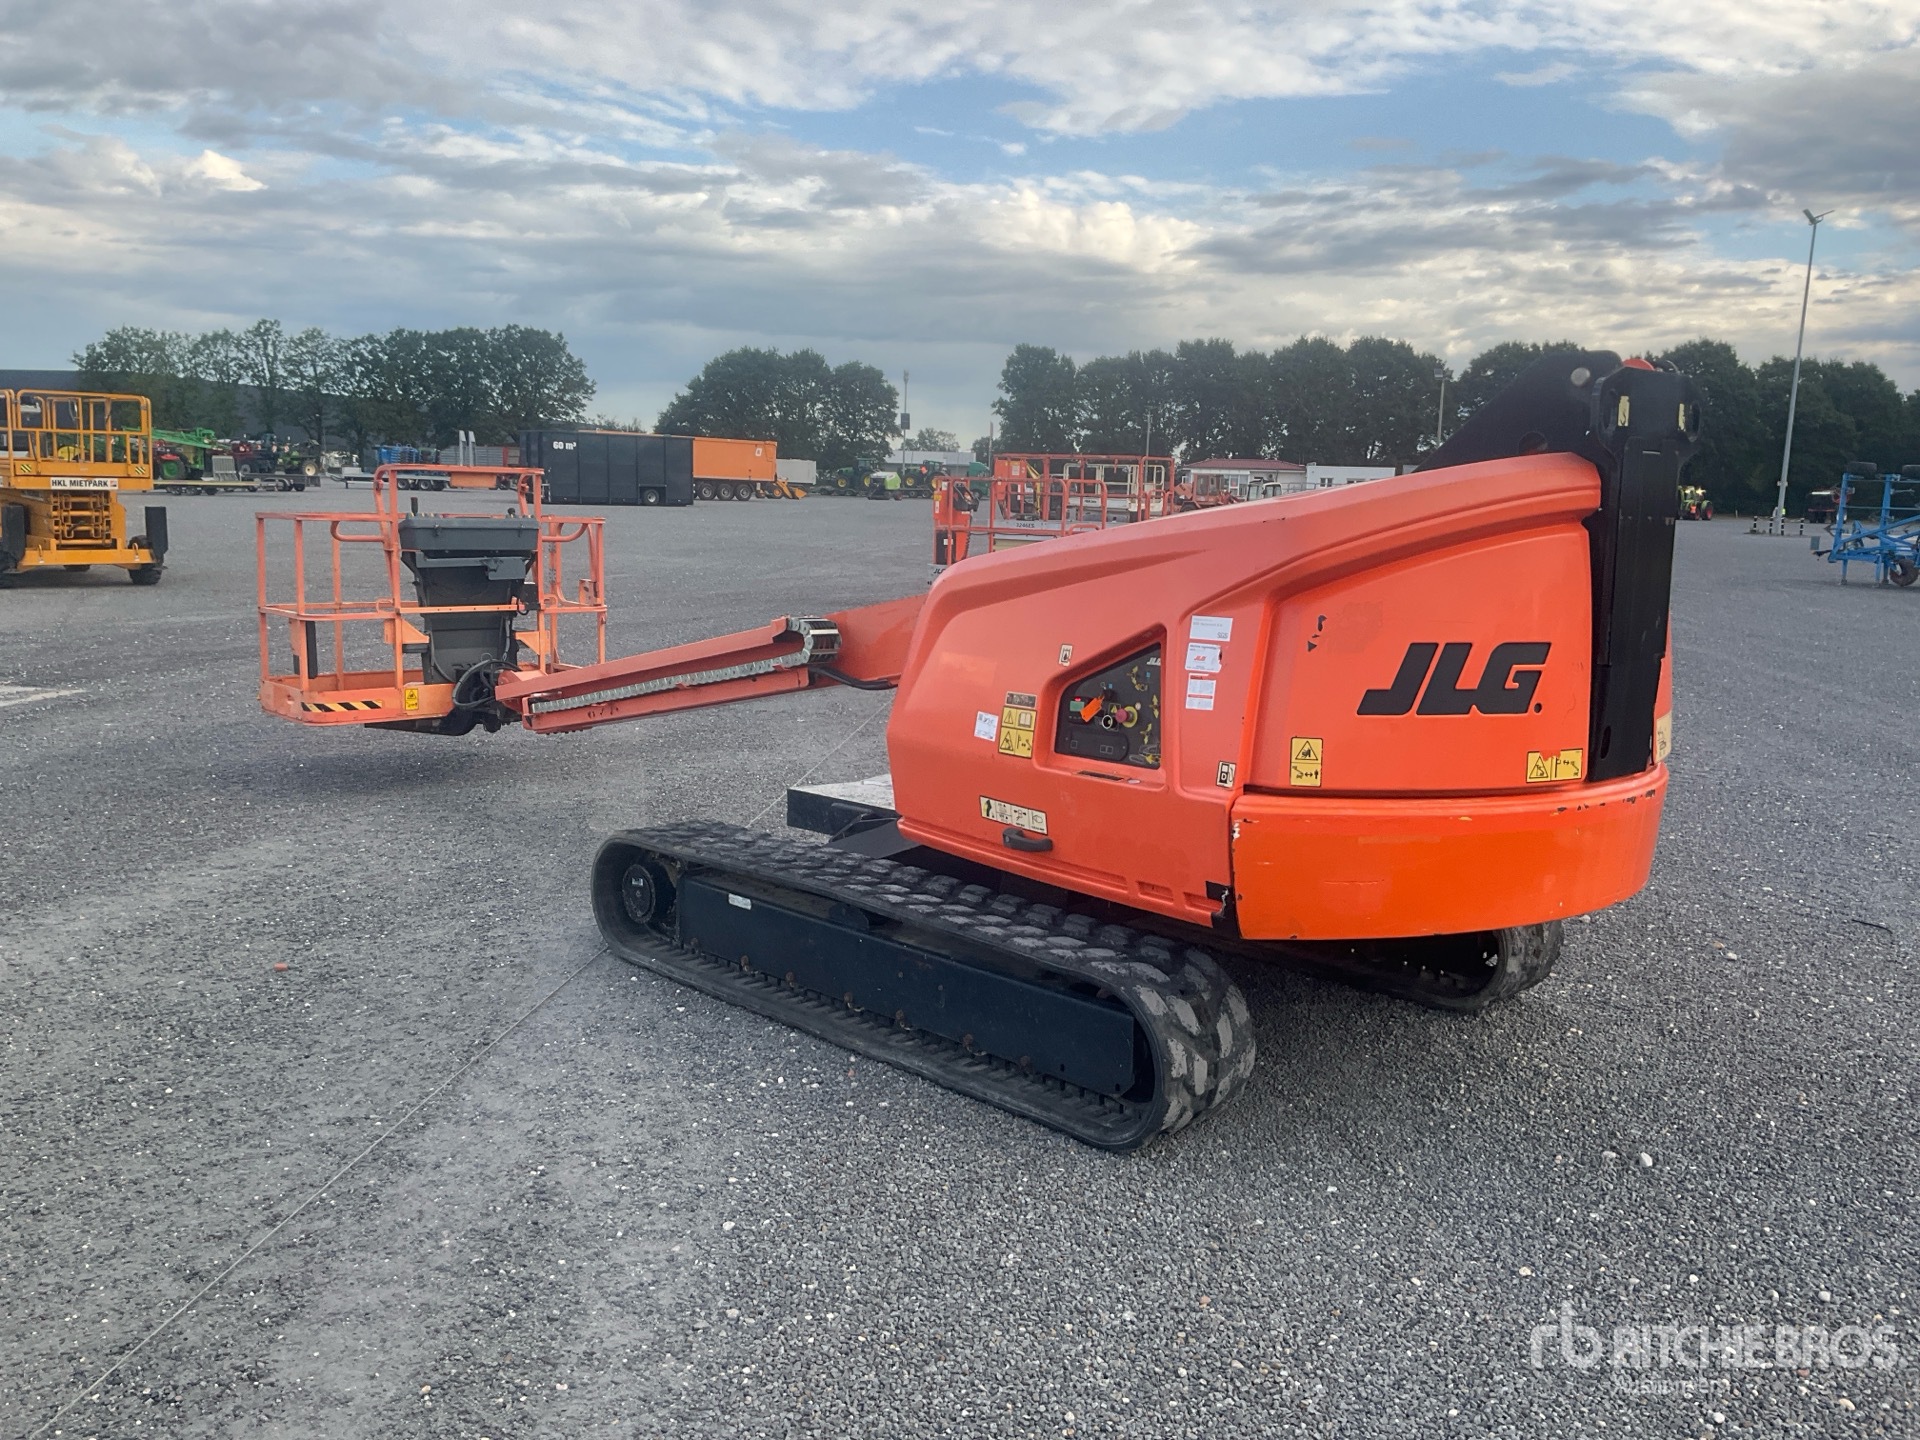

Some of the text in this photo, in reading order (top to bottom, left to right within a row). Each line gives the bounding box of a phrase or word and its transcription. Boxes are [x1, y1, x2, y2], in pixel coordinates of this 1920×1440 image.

[553, 441, 564, 449] 60
[51, 479, 108, 487] HKL MIETPARK
[1356, 642, 1552, 716] JLG
